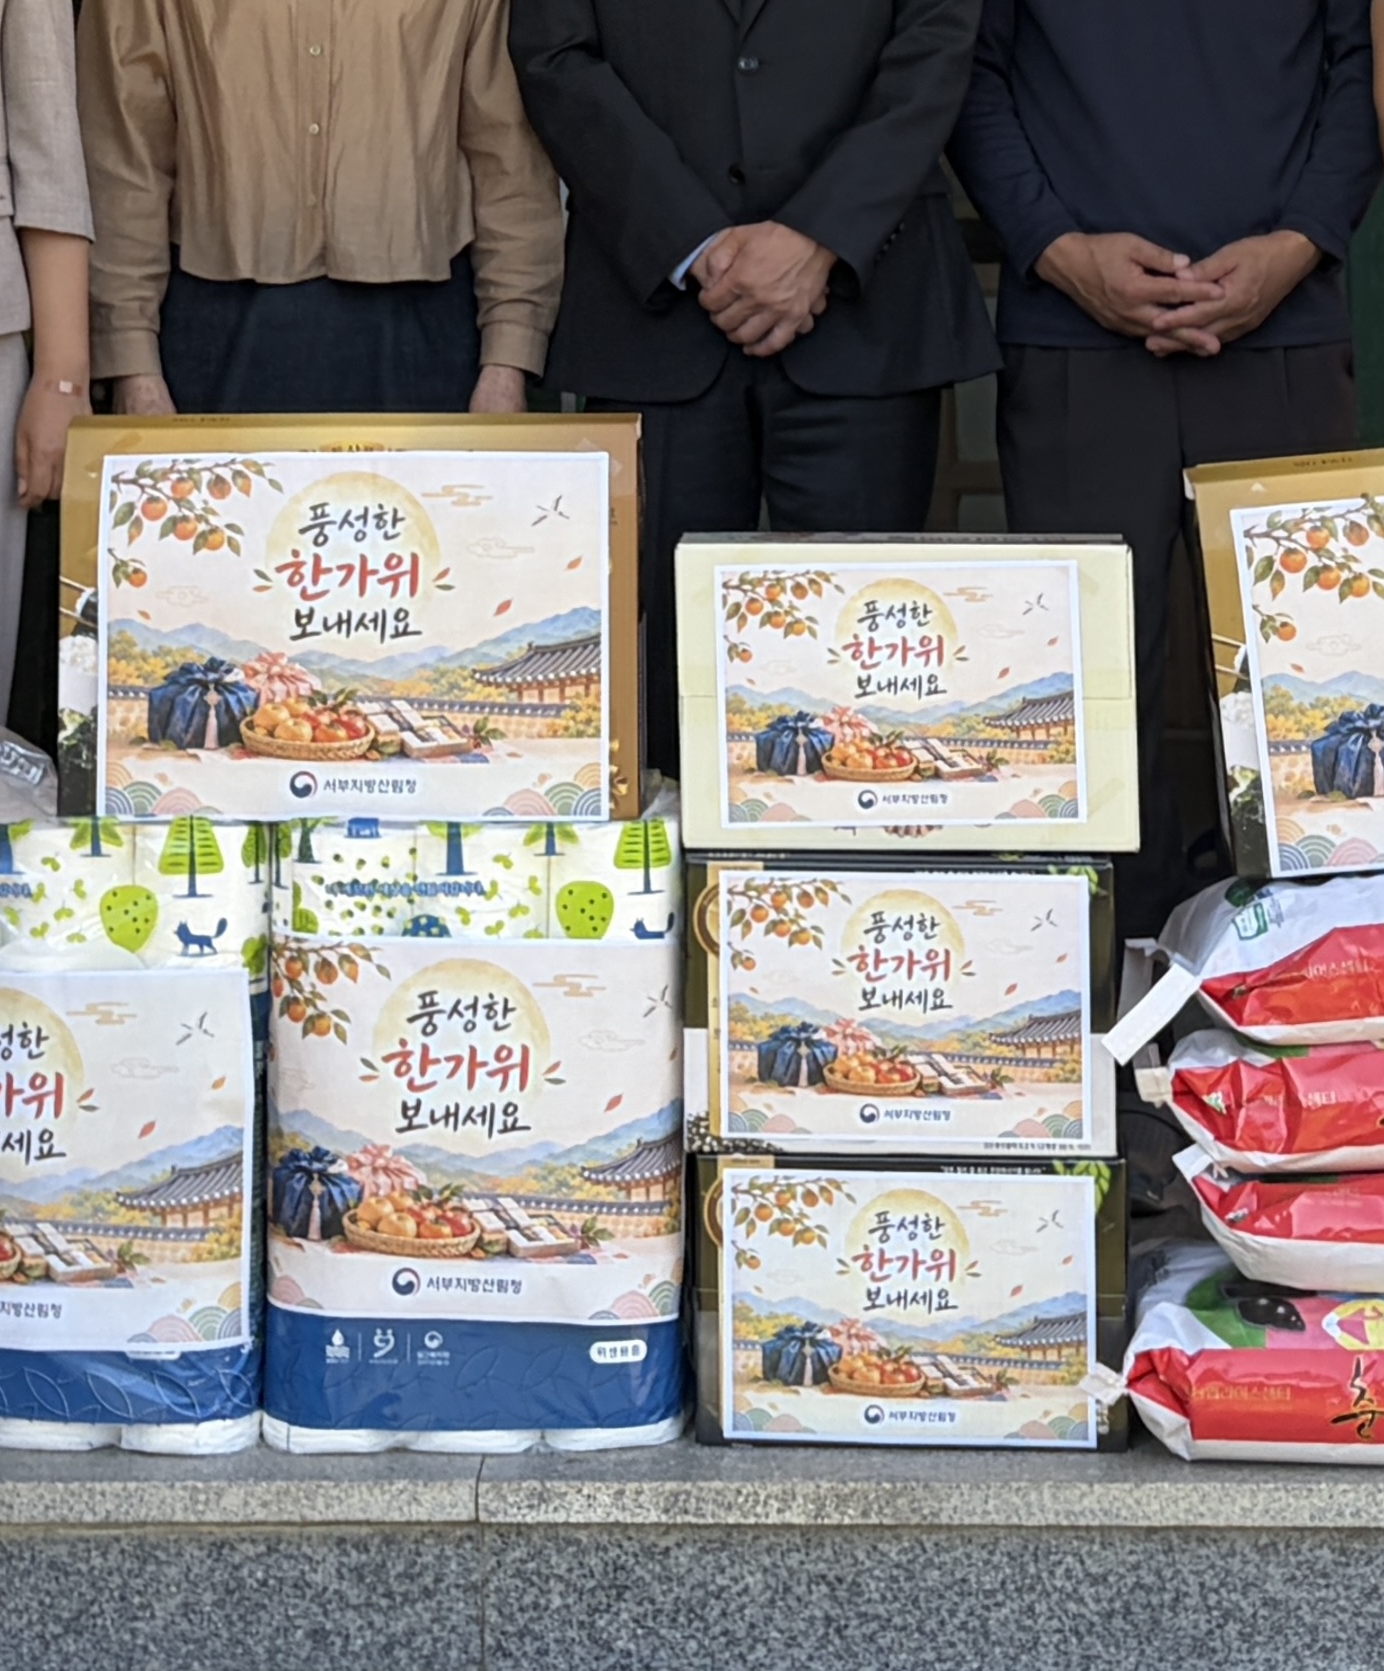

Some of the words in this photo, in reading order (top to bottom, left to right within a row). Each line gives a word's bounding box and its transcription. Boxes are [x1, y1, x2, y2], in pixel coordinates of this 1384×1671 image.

[298, 502, 406, 547] 풍성한
[275, 548, 420, 602] 한가위
[289, 605, 423, 645] 보내세요
[856, 598, 934, 633] 풍성한
[841, 635, 946, 672] 한가위
[853, 673, 949, 700] 보내세요
[322, 776, 418, 796] 서부지방산림청
[881, 792, 949, 807] 서부지방산림청
[862, 910, 940, 946] 풍성한
[848, 946, 952, 983] 한가위
[406, 989, 517, 1036] 풍성한
[857, 985, 954, 1015] 보내세요
[381, 1040, 531, 1095] 한가위
[395, 1098, 532, 1140] 보내세요
[883, 1107, 952, 1123] 서부지방산림청
[868, 1209, 946, 1246] 풍성한
[852, 1246, 957, 1284] 한가위
[425, 1275, 524, 1296] 서부지방산림청
[862, 1285, 959, 1315] 보내세요
[888, 1408, 957, 1424] 서부지방산림청
